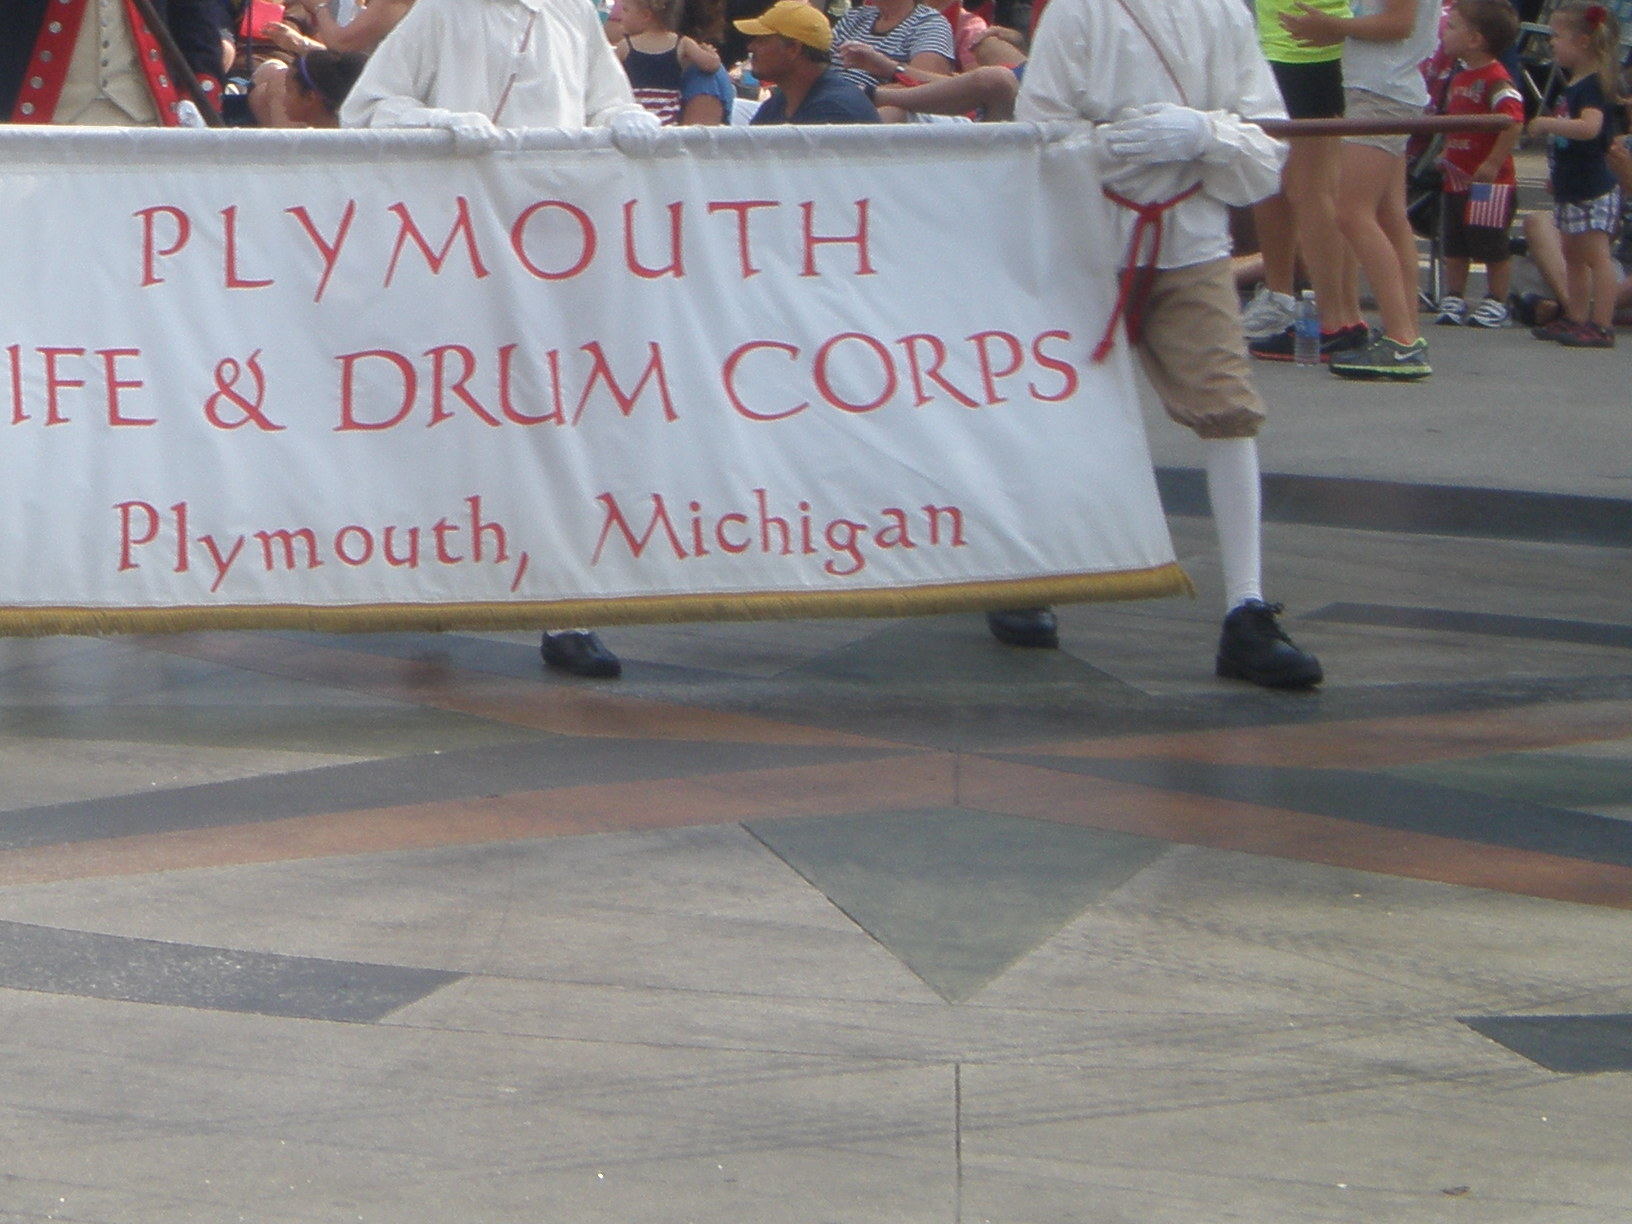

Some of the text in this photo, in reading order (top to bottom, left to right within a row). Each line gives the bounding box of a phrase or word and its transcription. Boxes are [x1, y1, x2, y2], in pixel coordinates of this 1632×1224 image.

[133, 196, 875, 301] PLYMOUTH
[204, 347, 287, 433] &
[335, 340, 679, 432] DRUM
[722, 329, 1079, 422] CORPS
[114, 488, 967, 592] Plymouth, Michigan
